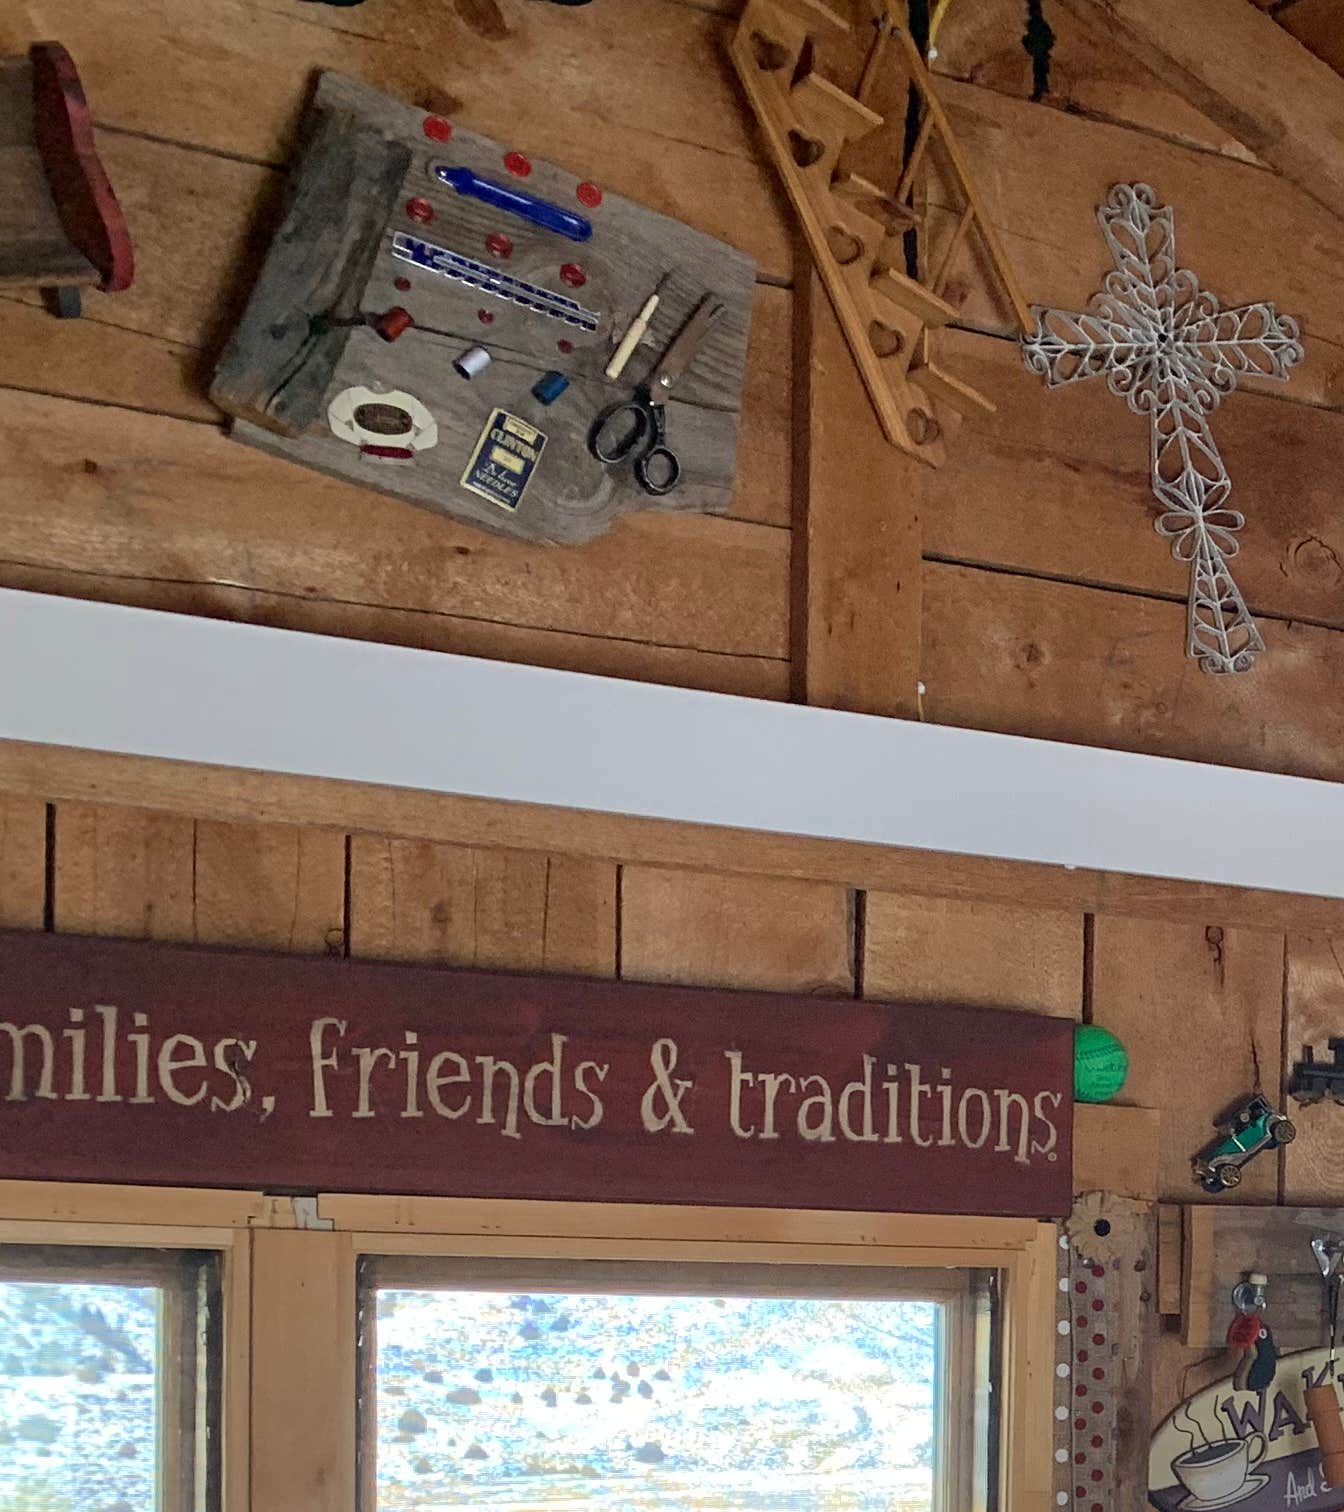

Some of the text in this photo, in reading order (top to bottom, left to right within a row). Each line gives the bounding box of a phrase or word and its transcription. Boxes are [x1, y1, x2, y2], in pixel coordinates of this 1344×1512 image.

[309, 1017, 610, 1139] friends
[641, 1038, 695, 1133] &
[1283, 1467, 1317, 1509] And
